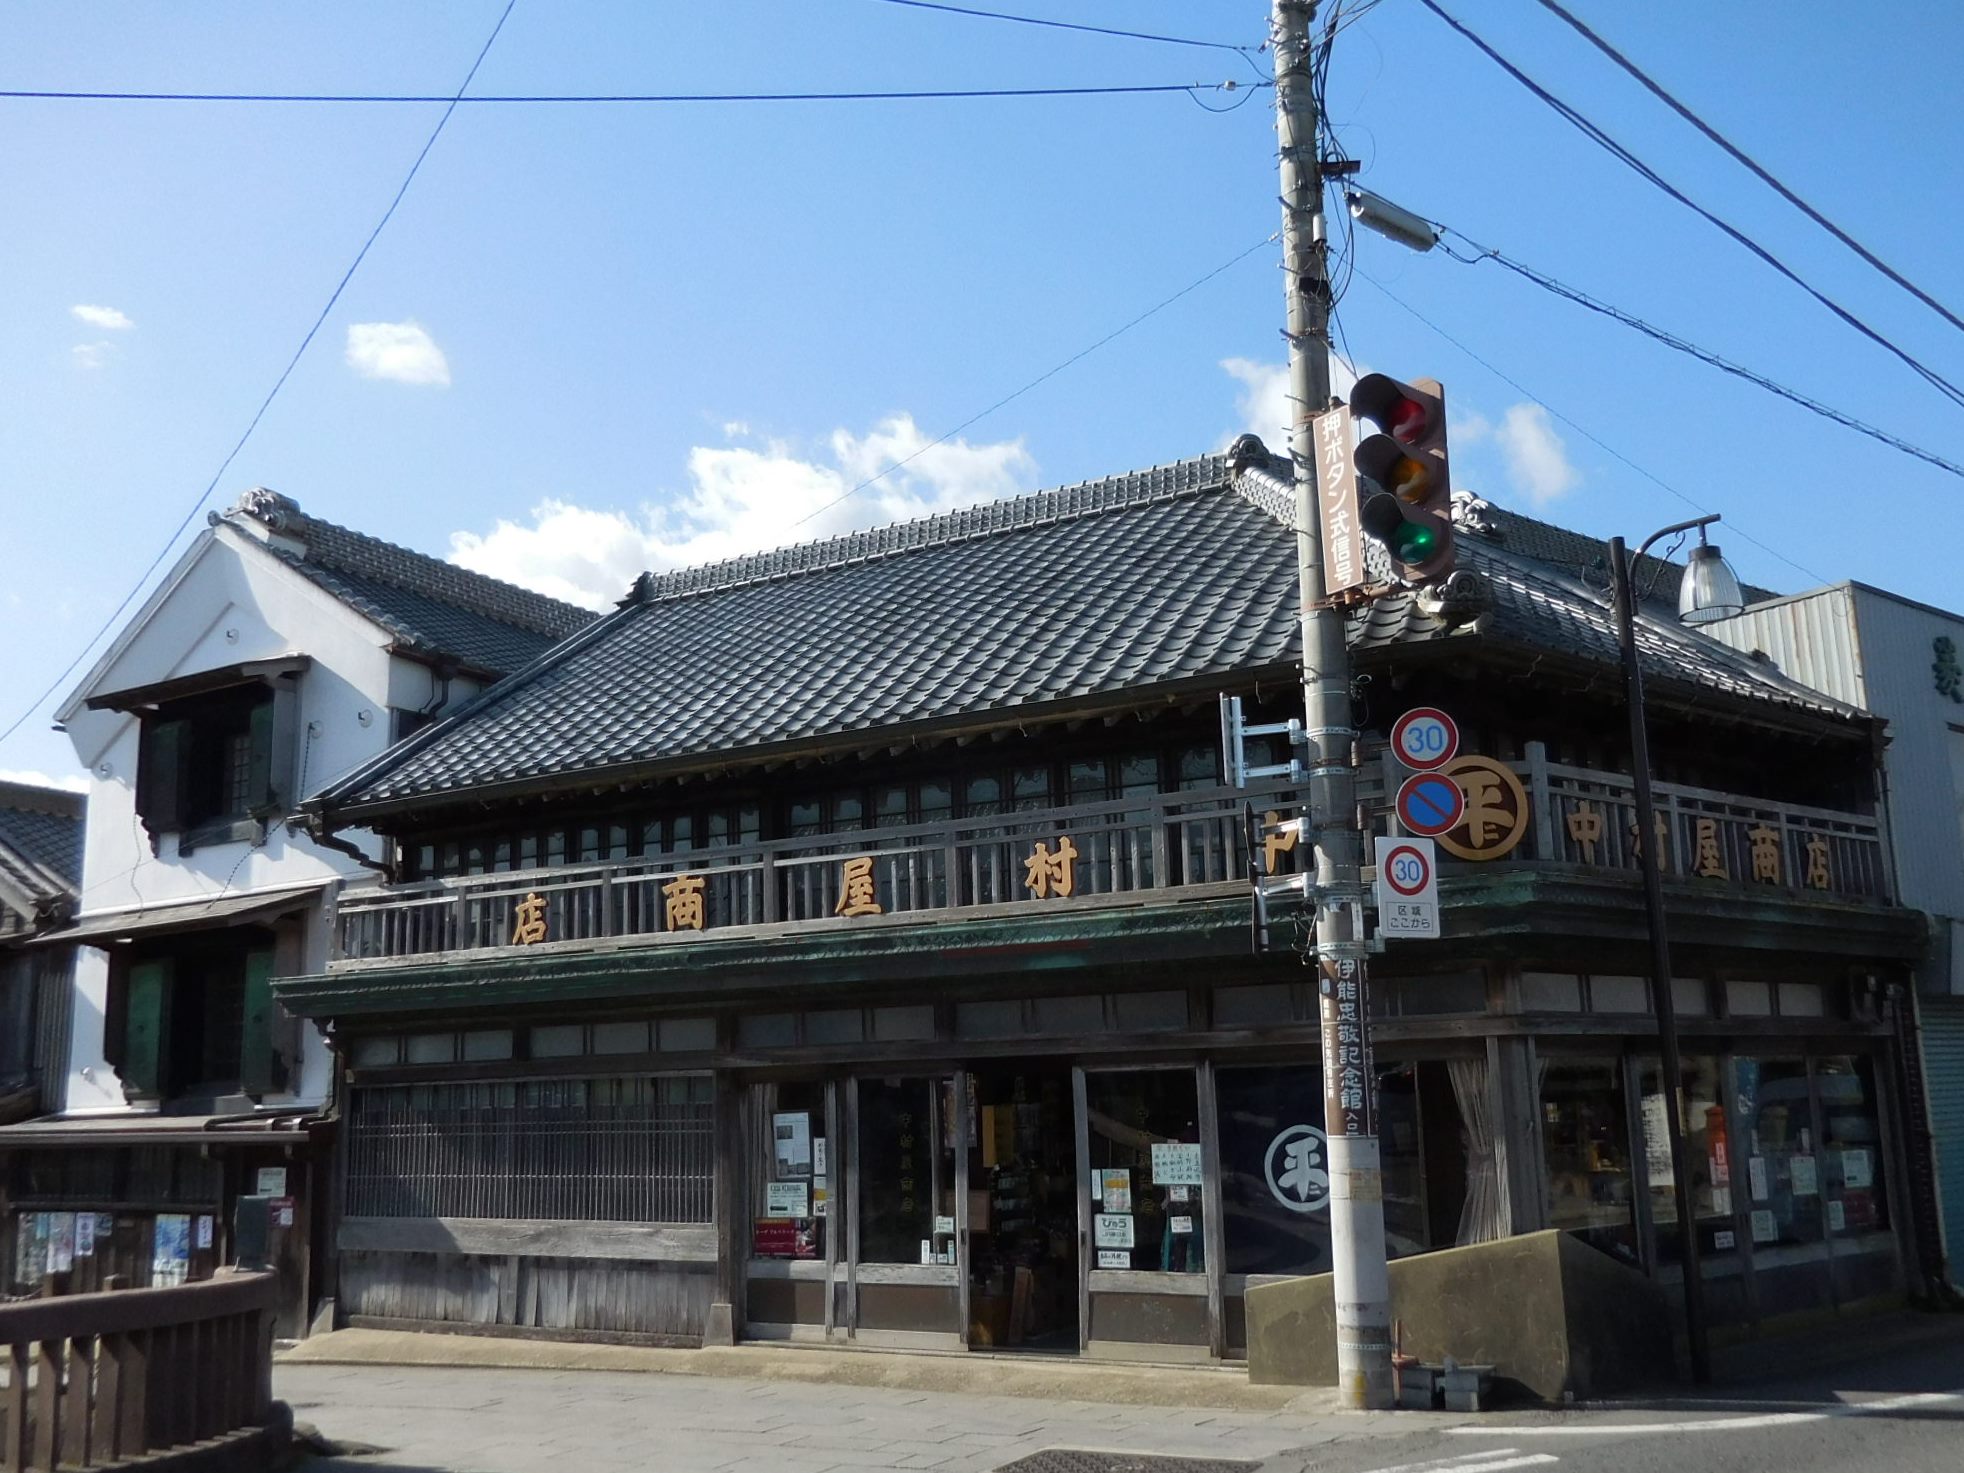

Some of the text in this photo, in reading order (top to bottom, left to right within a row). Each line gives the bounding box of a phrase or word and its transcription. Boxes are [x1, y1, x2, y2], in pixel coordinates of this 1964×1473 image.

[1321, 414, 1353, 587] 押ボタン式信号
[1408, 726, 1443, 752] 30
[1395, 860, 1420, 882] 30
[1390, 917, 1431, 929] ここから
